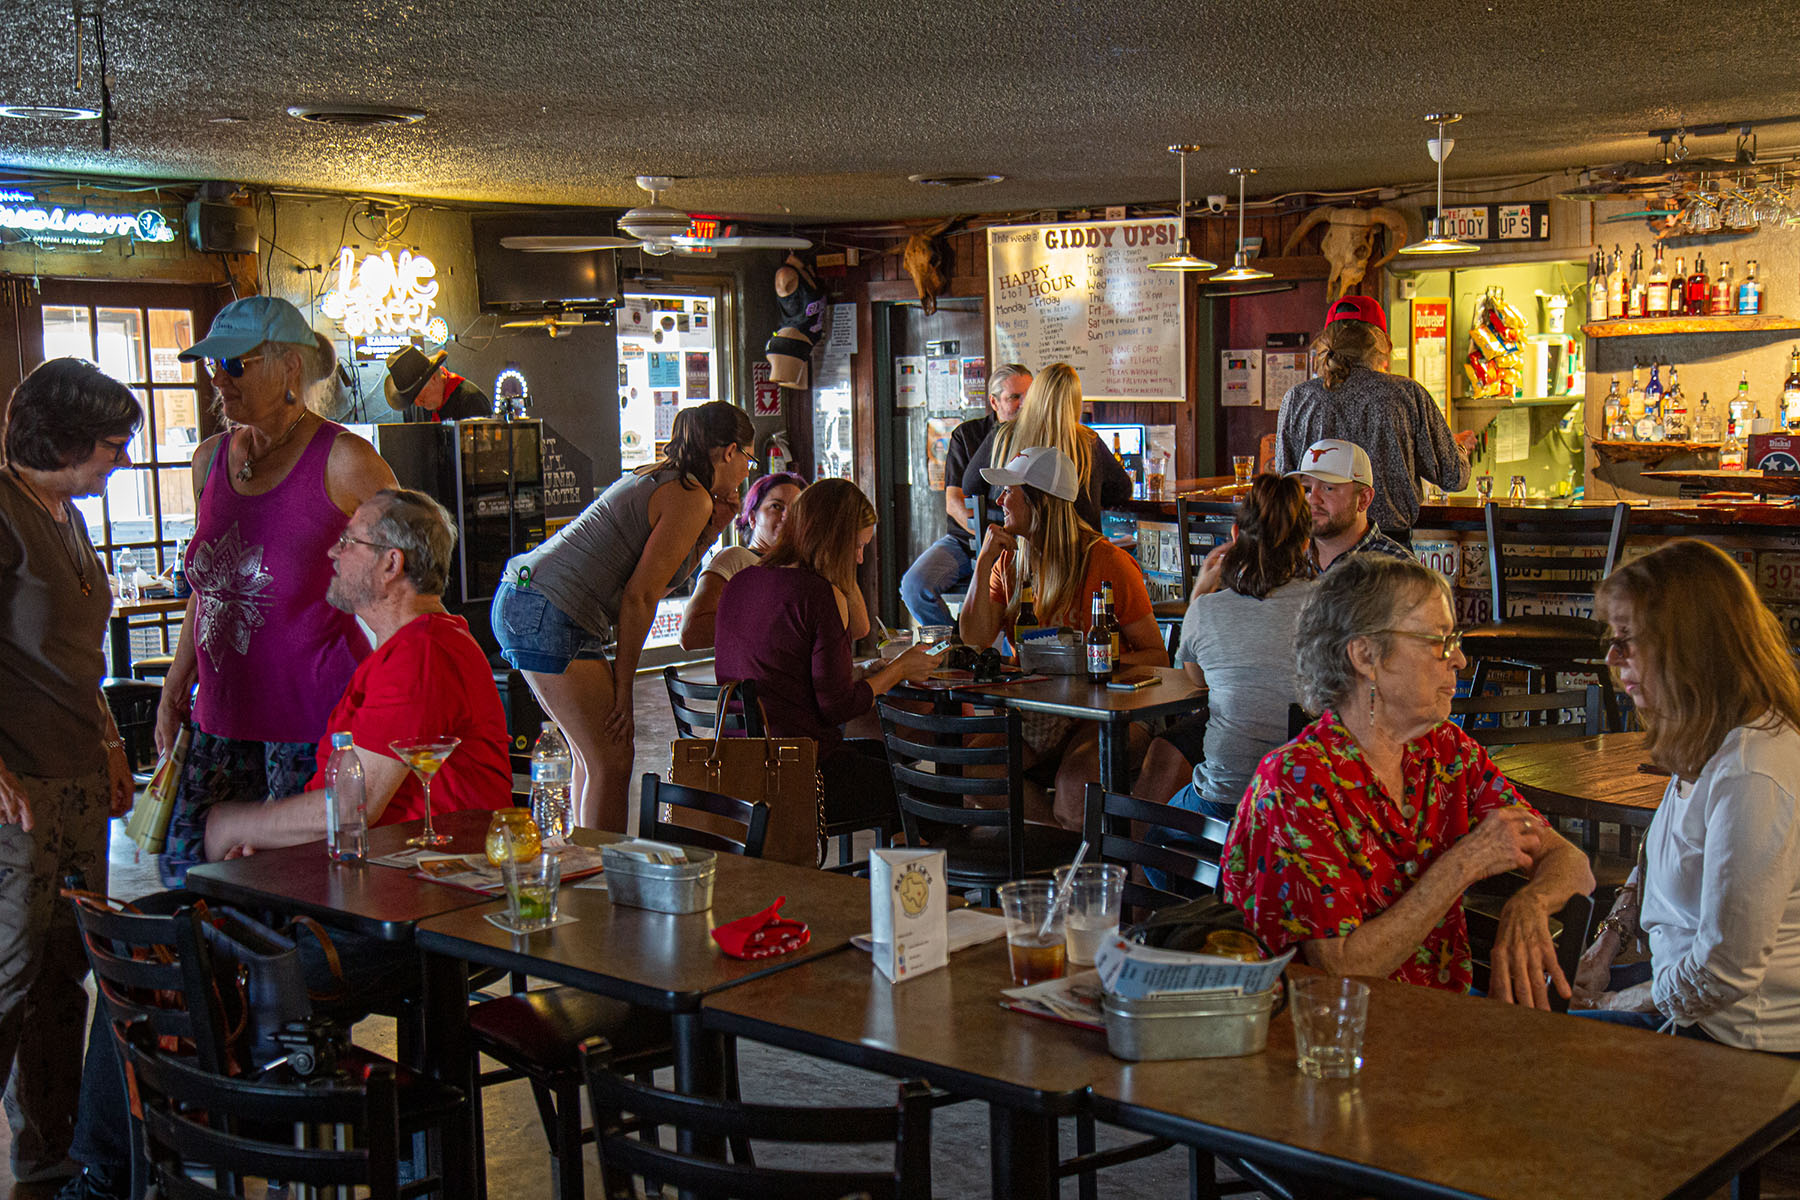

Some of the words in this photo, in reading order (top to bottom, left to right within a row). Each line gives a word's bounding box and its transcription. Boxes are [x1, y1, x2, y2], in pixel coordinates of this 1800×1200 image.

[1045, 227, 1117, 249] GIDDY
[1123, 223, 1176, 247] UPS!
[1087, 253, 1104, 265] Mon
[998, 265, 1049, 290] HAPPY
[1028, 274, 1076, 298] HOUR
[996, 301, 1027, 315] Monday
[1416, 309, 1445, 328] Budweiser
